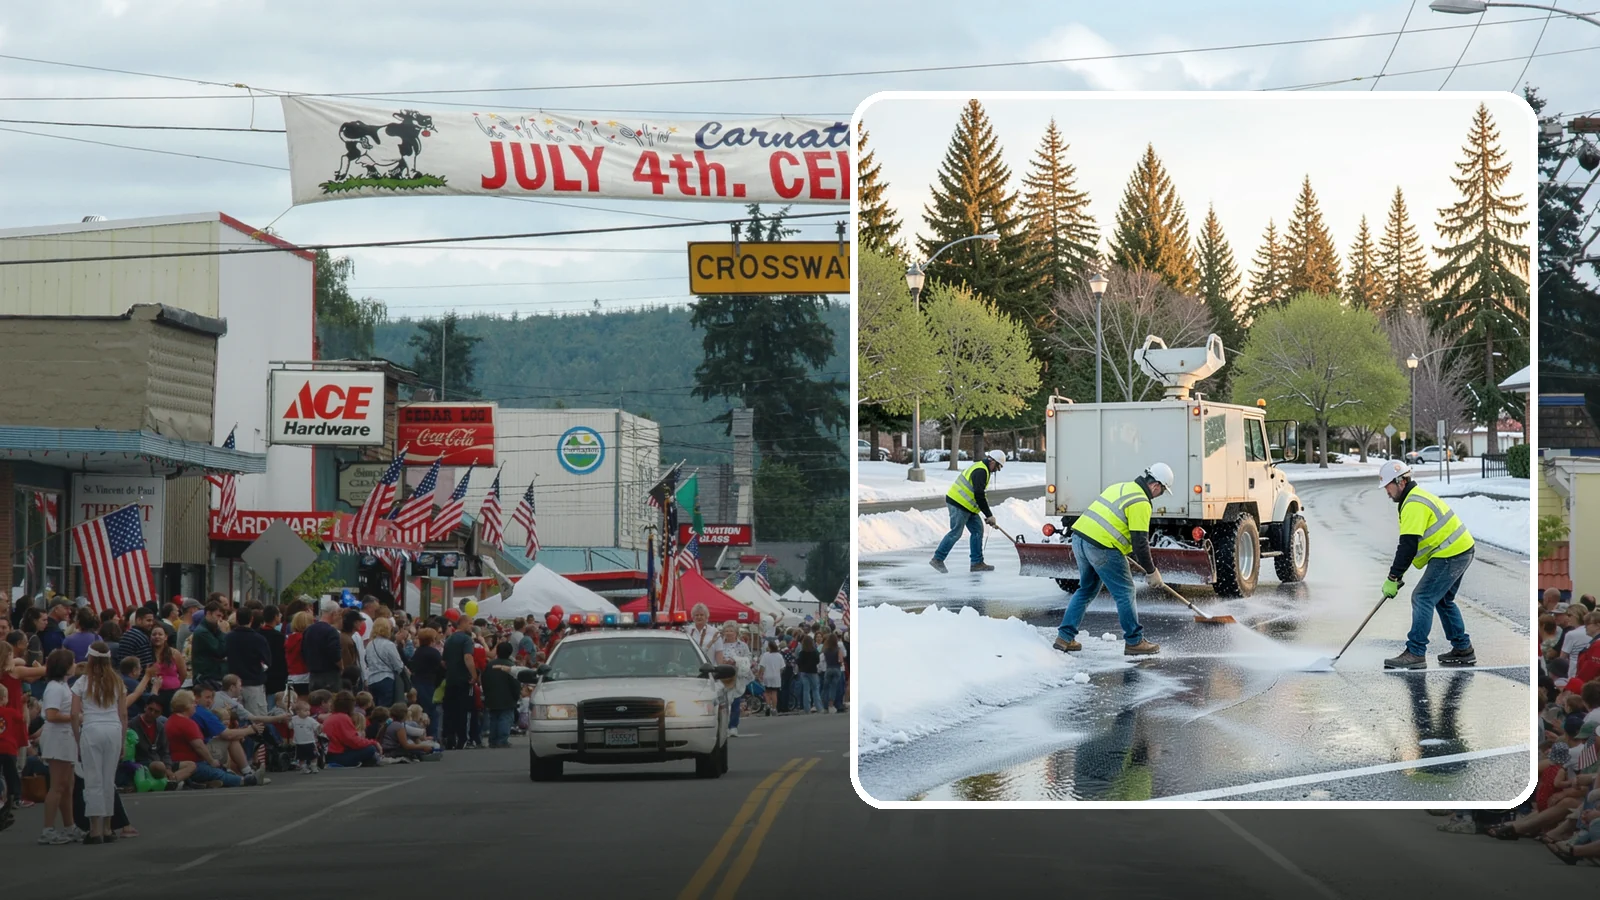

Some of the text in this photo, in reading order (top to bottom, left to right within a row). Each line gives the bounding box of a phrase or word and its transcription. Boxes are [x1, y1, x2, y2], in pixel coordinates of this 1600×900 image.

[481, 140, 605, 192] JULY
[632, 149, 746, 198] 4th.
[697, 254, 850, 280] CROSSWA
[282, 380, 373, 420] ACE
[405, 409, 453, 421] CEDAR
[283, 421, 371, 437] Hardware
[96, 485, 125, 494] Vincent
[126, 486, 136, 494] de
[138, 486, 155, 495] Paul
[212, 515, 330, 536] HARDARE
[688, 526, 741, 535] CRNATION
[699, 535, 730, 543] GLASS
